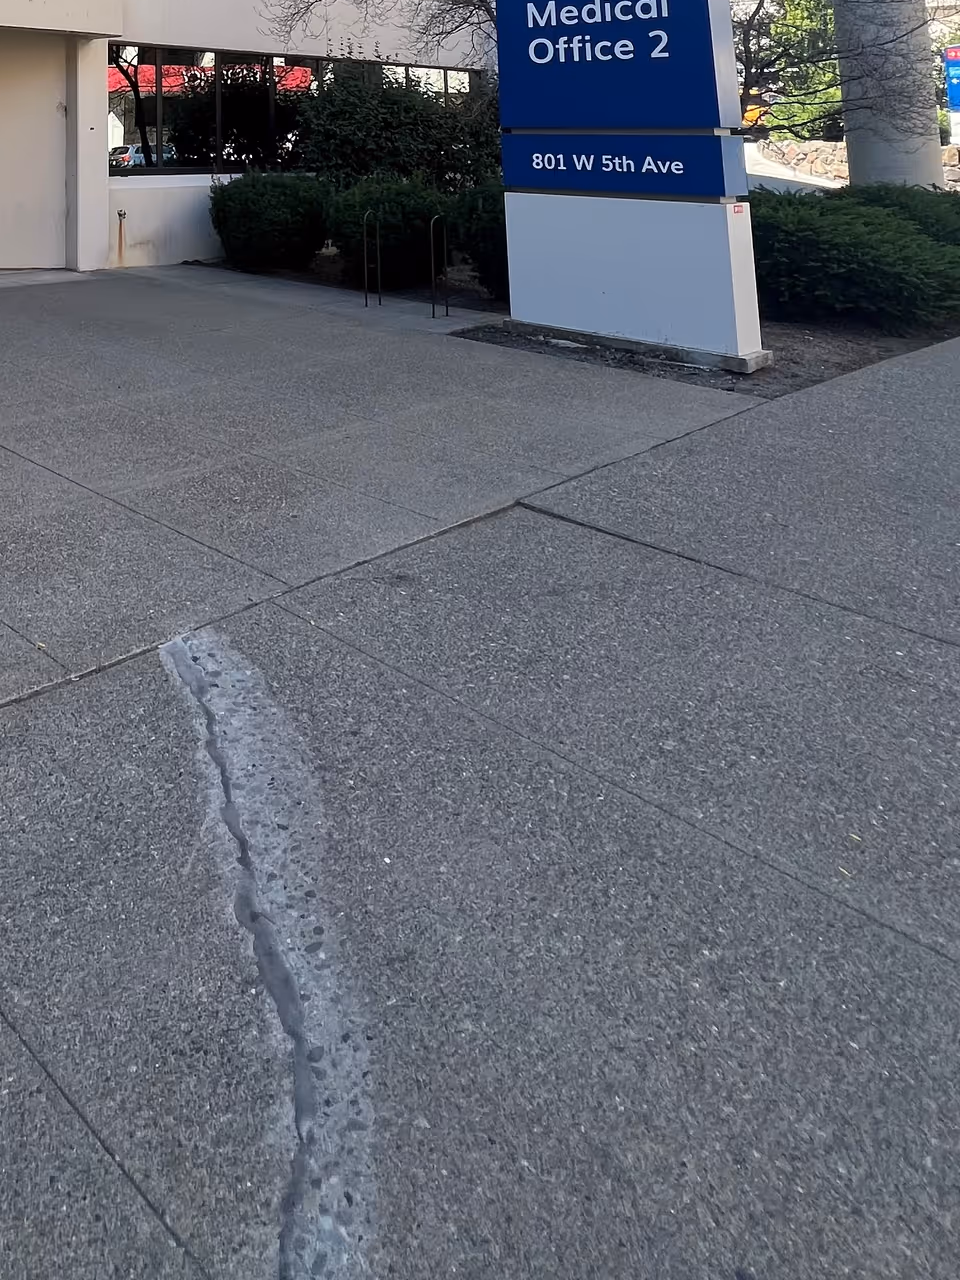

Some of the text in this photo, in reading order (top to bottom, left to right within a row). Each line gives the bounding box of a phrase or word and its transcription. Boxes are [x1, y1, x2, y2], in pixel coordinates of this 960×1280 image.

[528, 30, 670, 64] Office 2
[532, 153, 684, 174] 801 W 5th Ave
